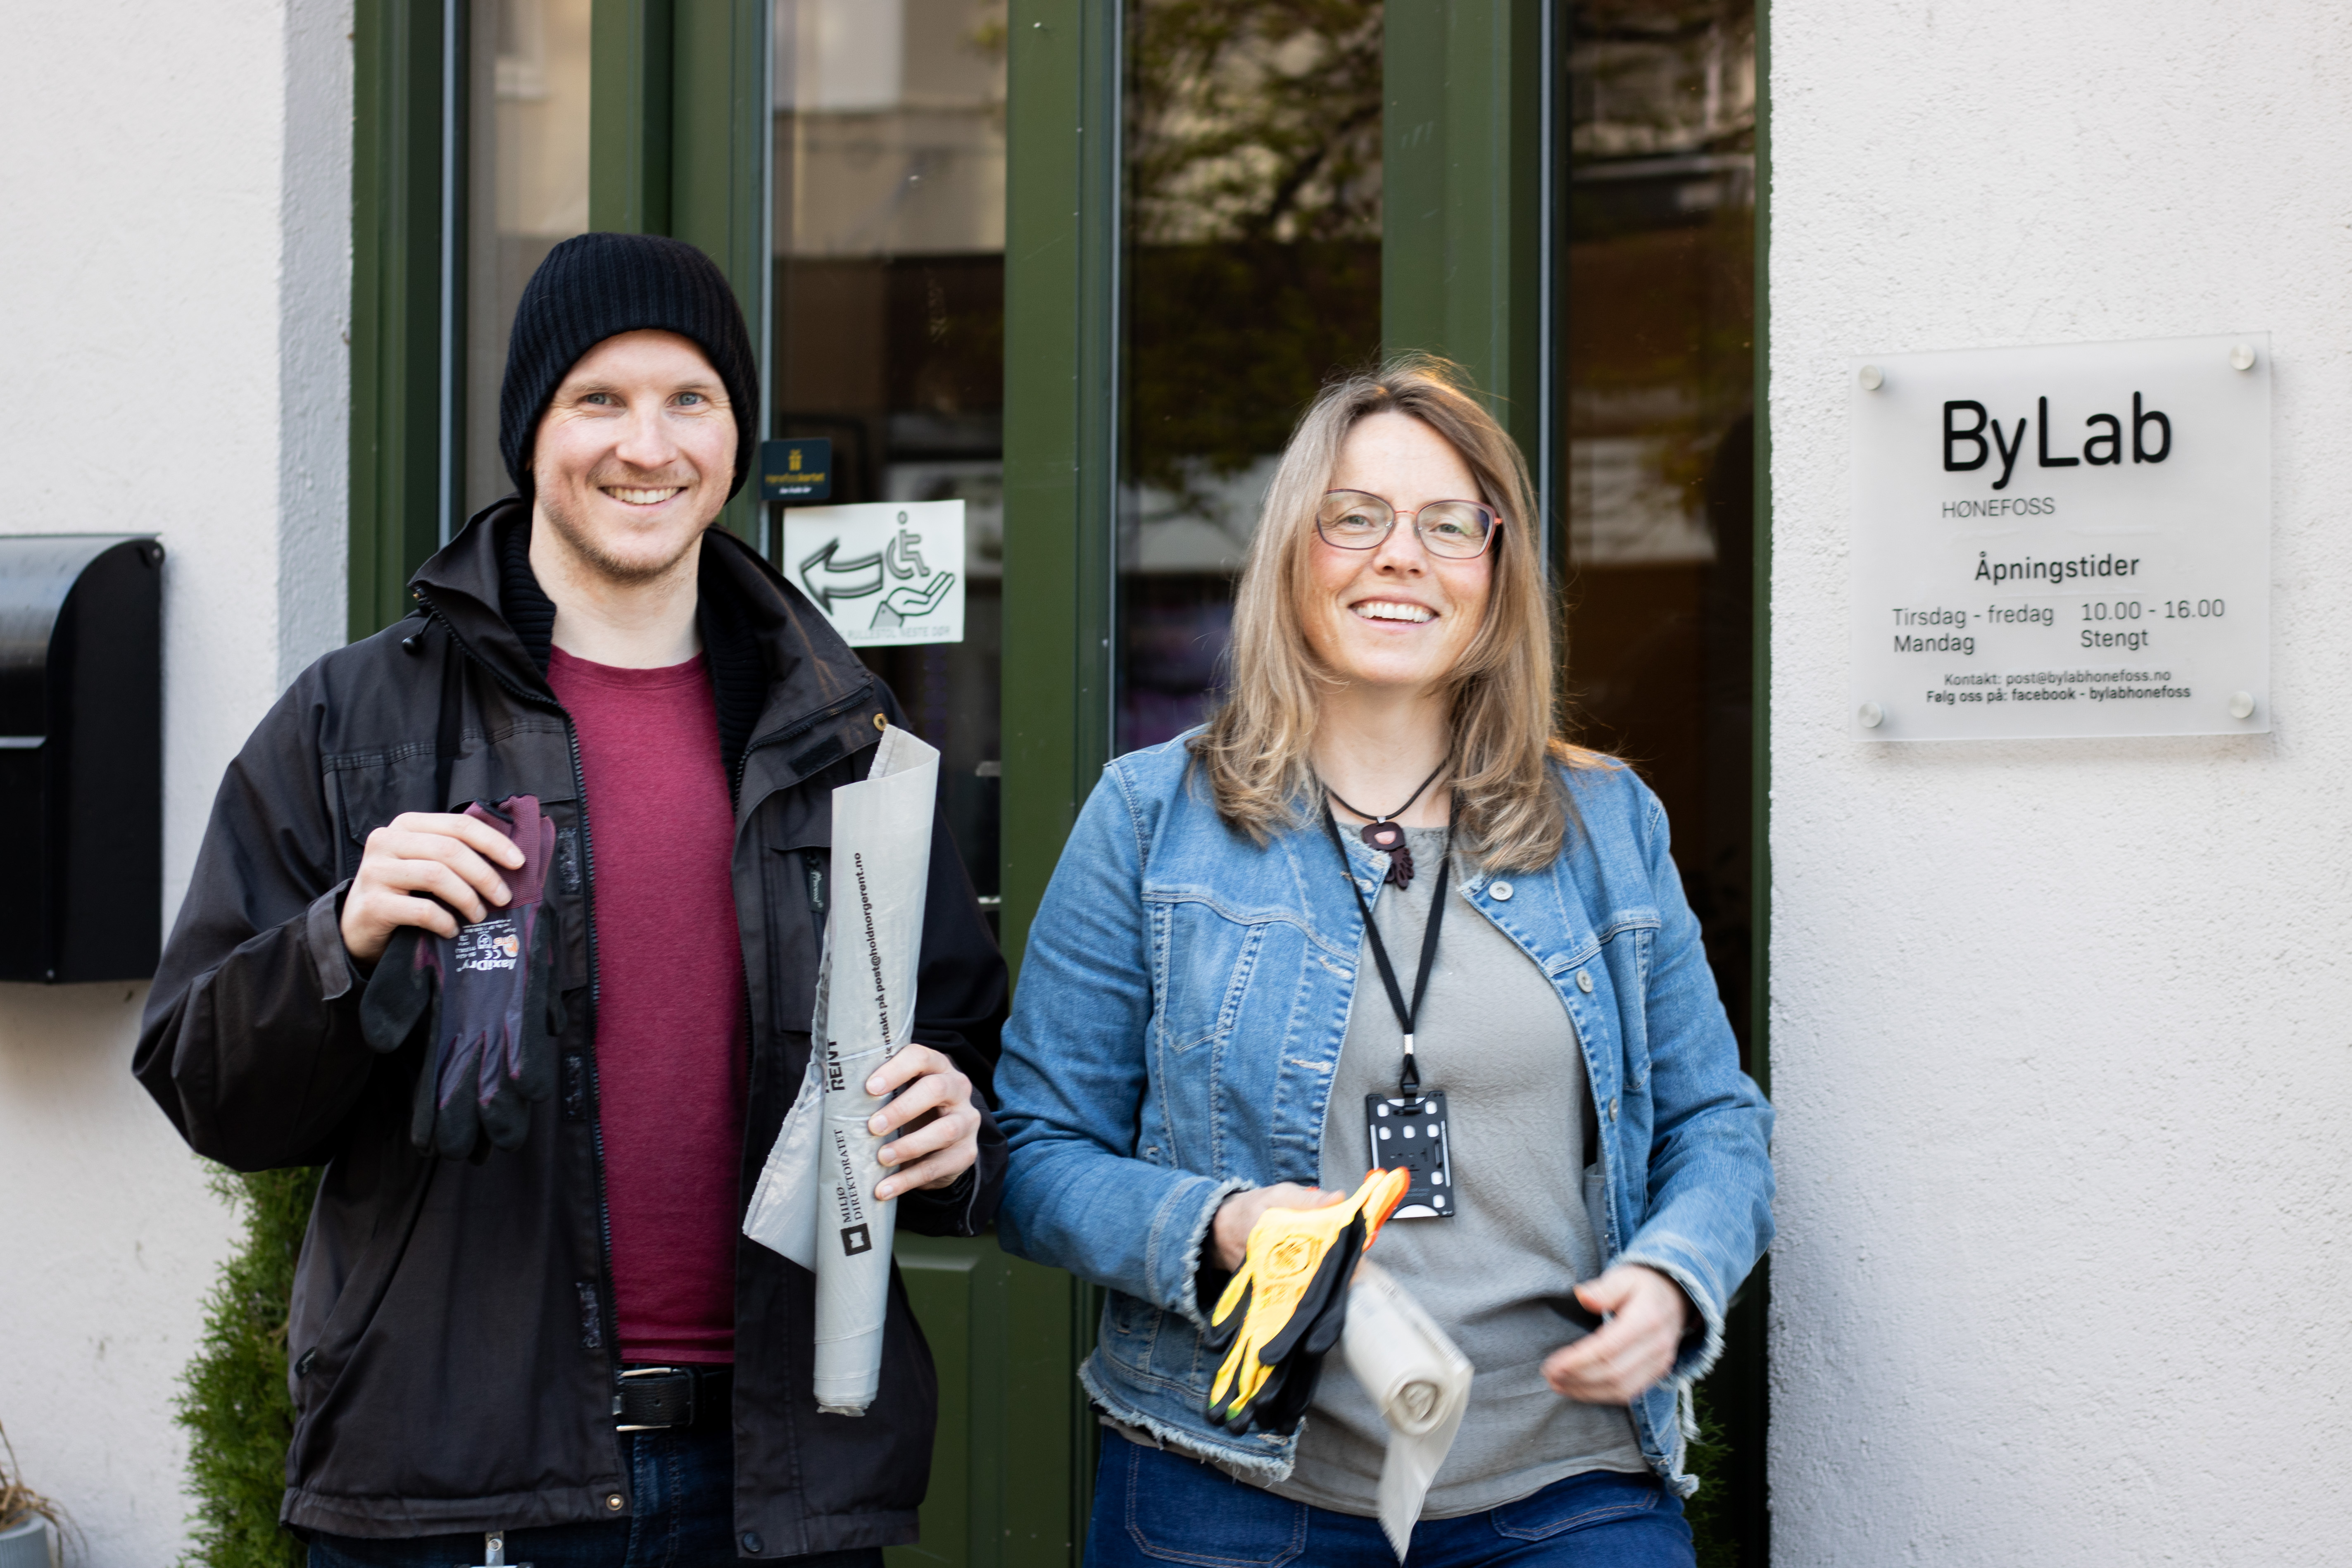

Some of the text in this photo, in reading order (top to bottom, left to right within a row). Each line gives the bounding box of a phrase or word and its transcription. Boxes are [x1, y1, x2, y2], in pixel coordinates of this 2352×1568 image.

[1943, 390, 2173, 491] ByLab
[1943, 497, 2055, 518] HØNEFOSS
[1974, 551, 2140, 586] Åpningstider
[1892, 607, 1967, 629] Tirsdag
[1988, 604, 2054, 627] fredag
[2082, 601, 2141, 621] 10.00
[2165, 598, 2225, 619] 16.00
[1894, 633, 1975, 656] Mandag
[2081, 629, 2149, 652] Stengt
[1944, 669, 2171, 688] Kontakt: post@bylabhonefoss.no
[1926, 690, 1956, 706] Følg
[1959, 692, 1983, 702] oss
[1986, 688, 2007, 704] på:
[2012, 688, 2076, 701] facebook
[2089, 685, 2191, 702] bylabhonefoss
[854, 852, 885, 992] post@holdnorgerent.no
[875, 994, 888, 1008] på
[833, 1129, 863, 1221] DIREKTORATET
